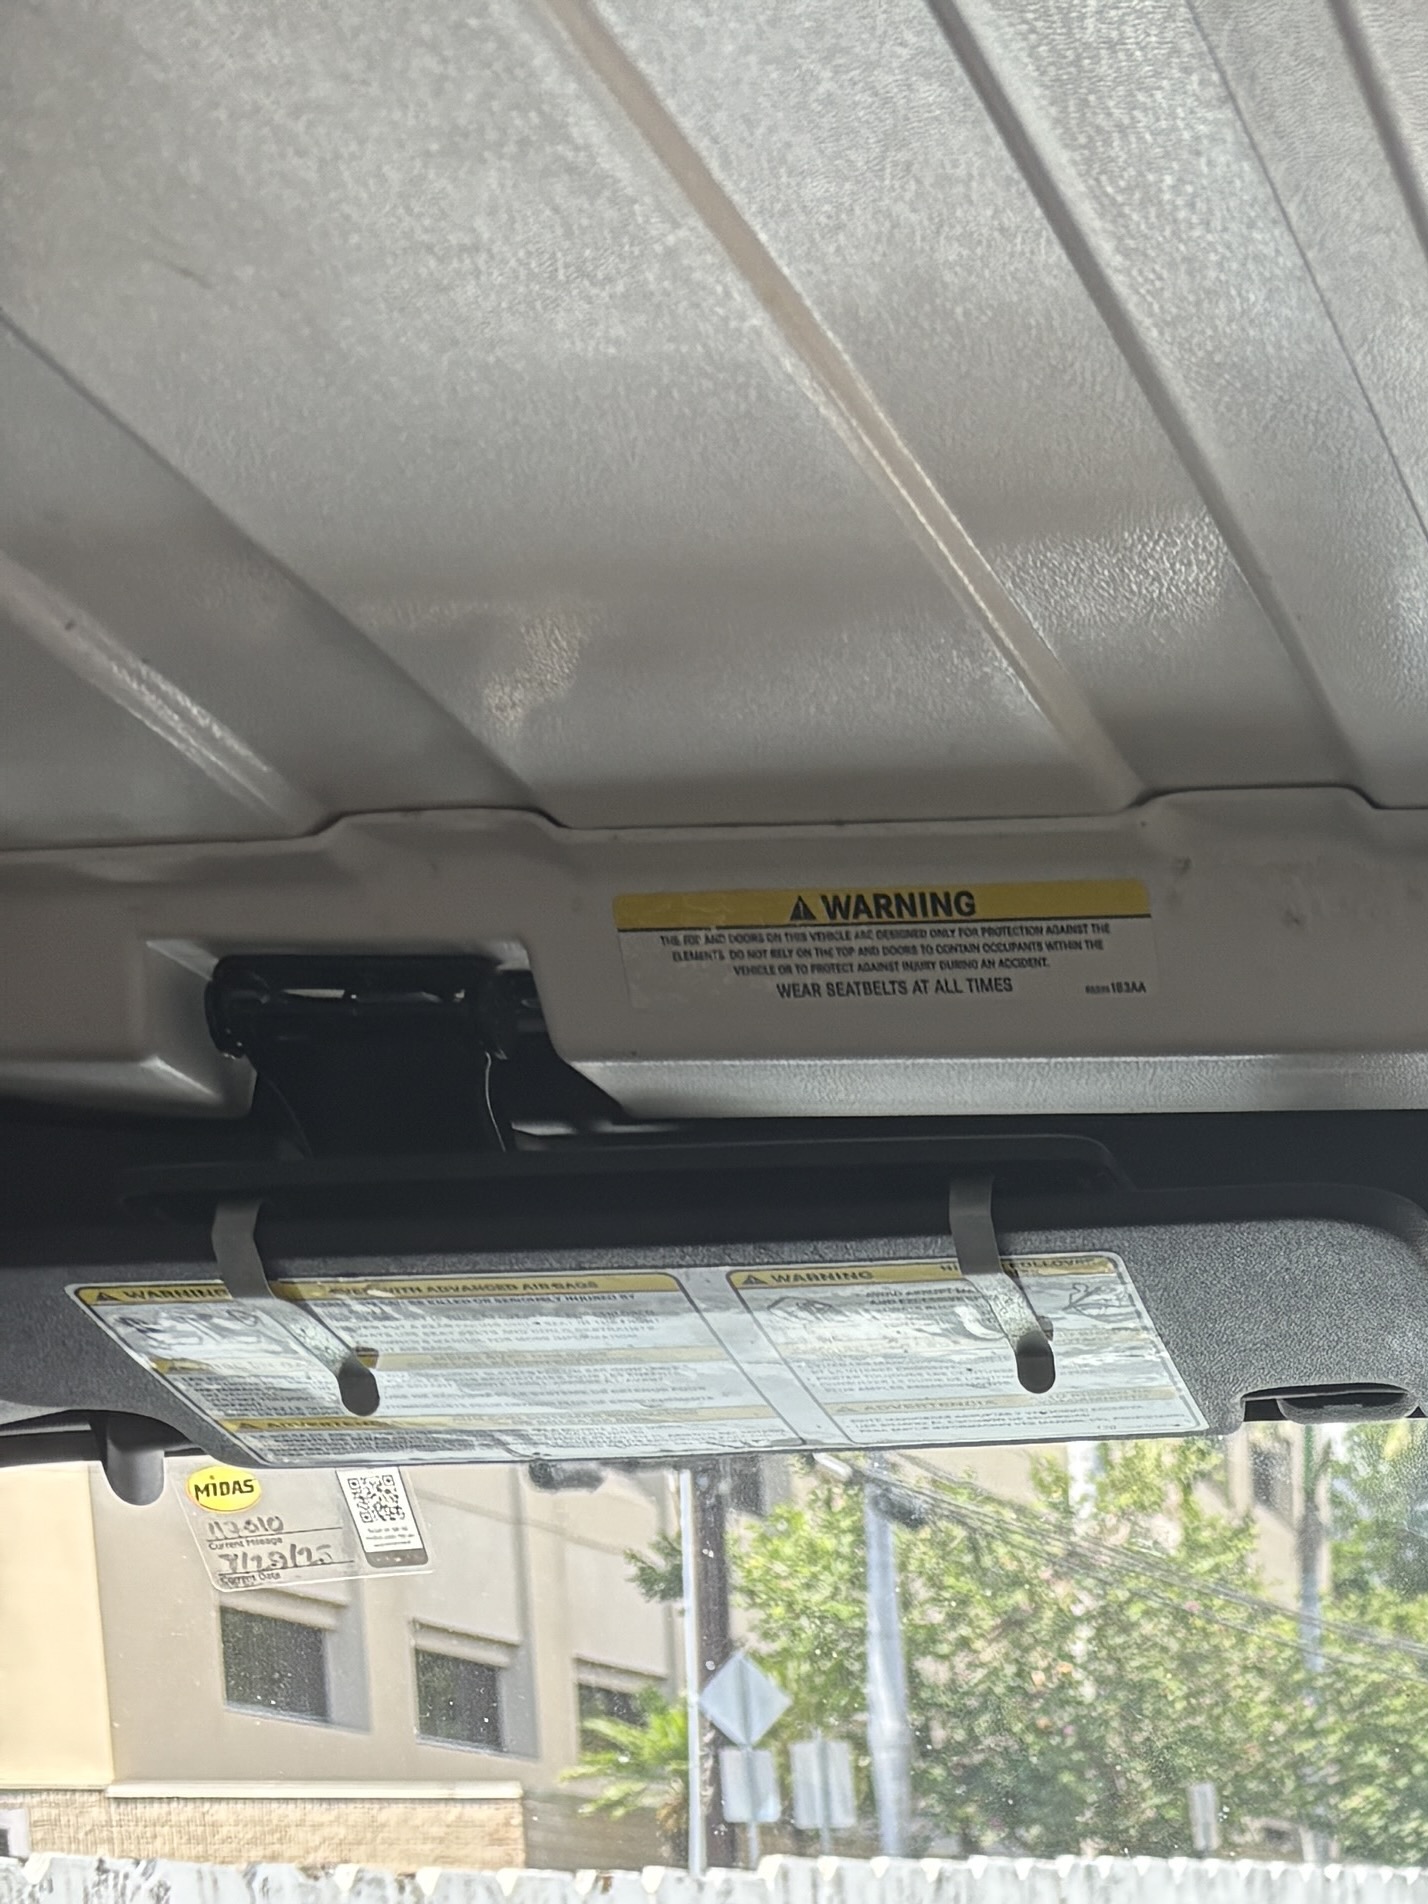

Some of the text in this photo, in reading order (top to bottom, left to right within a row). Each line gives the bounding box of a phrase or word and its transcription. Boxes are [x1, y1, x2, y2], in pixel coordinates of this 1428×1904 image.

[821, 891, 976, 920] WARNING
[729, 933, 764, 943] DOORS
[767, 932, 782, 943] ON
[809, 931, 852, 942] VEHICLE
[930, 928, 956, 939] ONLY
[958, 927, 978, 937] FOR
[981, 925, 1043, 937] PROTECTION
[1046, 924, 1088, 935] AGAINST
[1092, 922, 1110, 934] THE
[730, 950, 744, 960] DO
[747, 949, 767, 959] NOT
[770, 948, 793, 959] RELY
[796, 947, 811, 958] ON
[836, 946, 855, 957] TOP
[858, 946, 879, 956] AND
[882, 945, 918, 956] DOORS
[920, 944, 934, 955] TO
[936, 943, 980, 954] CONTAIN
[982, 941, 1044, 953] OCCUPANTS
[1045, 940, 1082, 952] WITHIN
[1085, 939, 1104, 950] THE
[733, 965, 776, 975] VEHICLE
[778, 964, 793, 975] OR
[795, 964, 809, 974] TO
[811, 963, 853, 974] PROTECT
[857, 961, 899, 972] AGAINST
[902, 960, 936, 971] INJURY
[939, 959, 978, 970] DURING
[980, 958, 996, 969] AN
[776, 977, 1013, 999] WEAR SEATBELTS AT ALL TIMES
[771, 1270, 874, 1284] WARNING
[194, 1474, 254, 1502] MIDAS
[209, 1537, 283, 1550] Current Mileage
